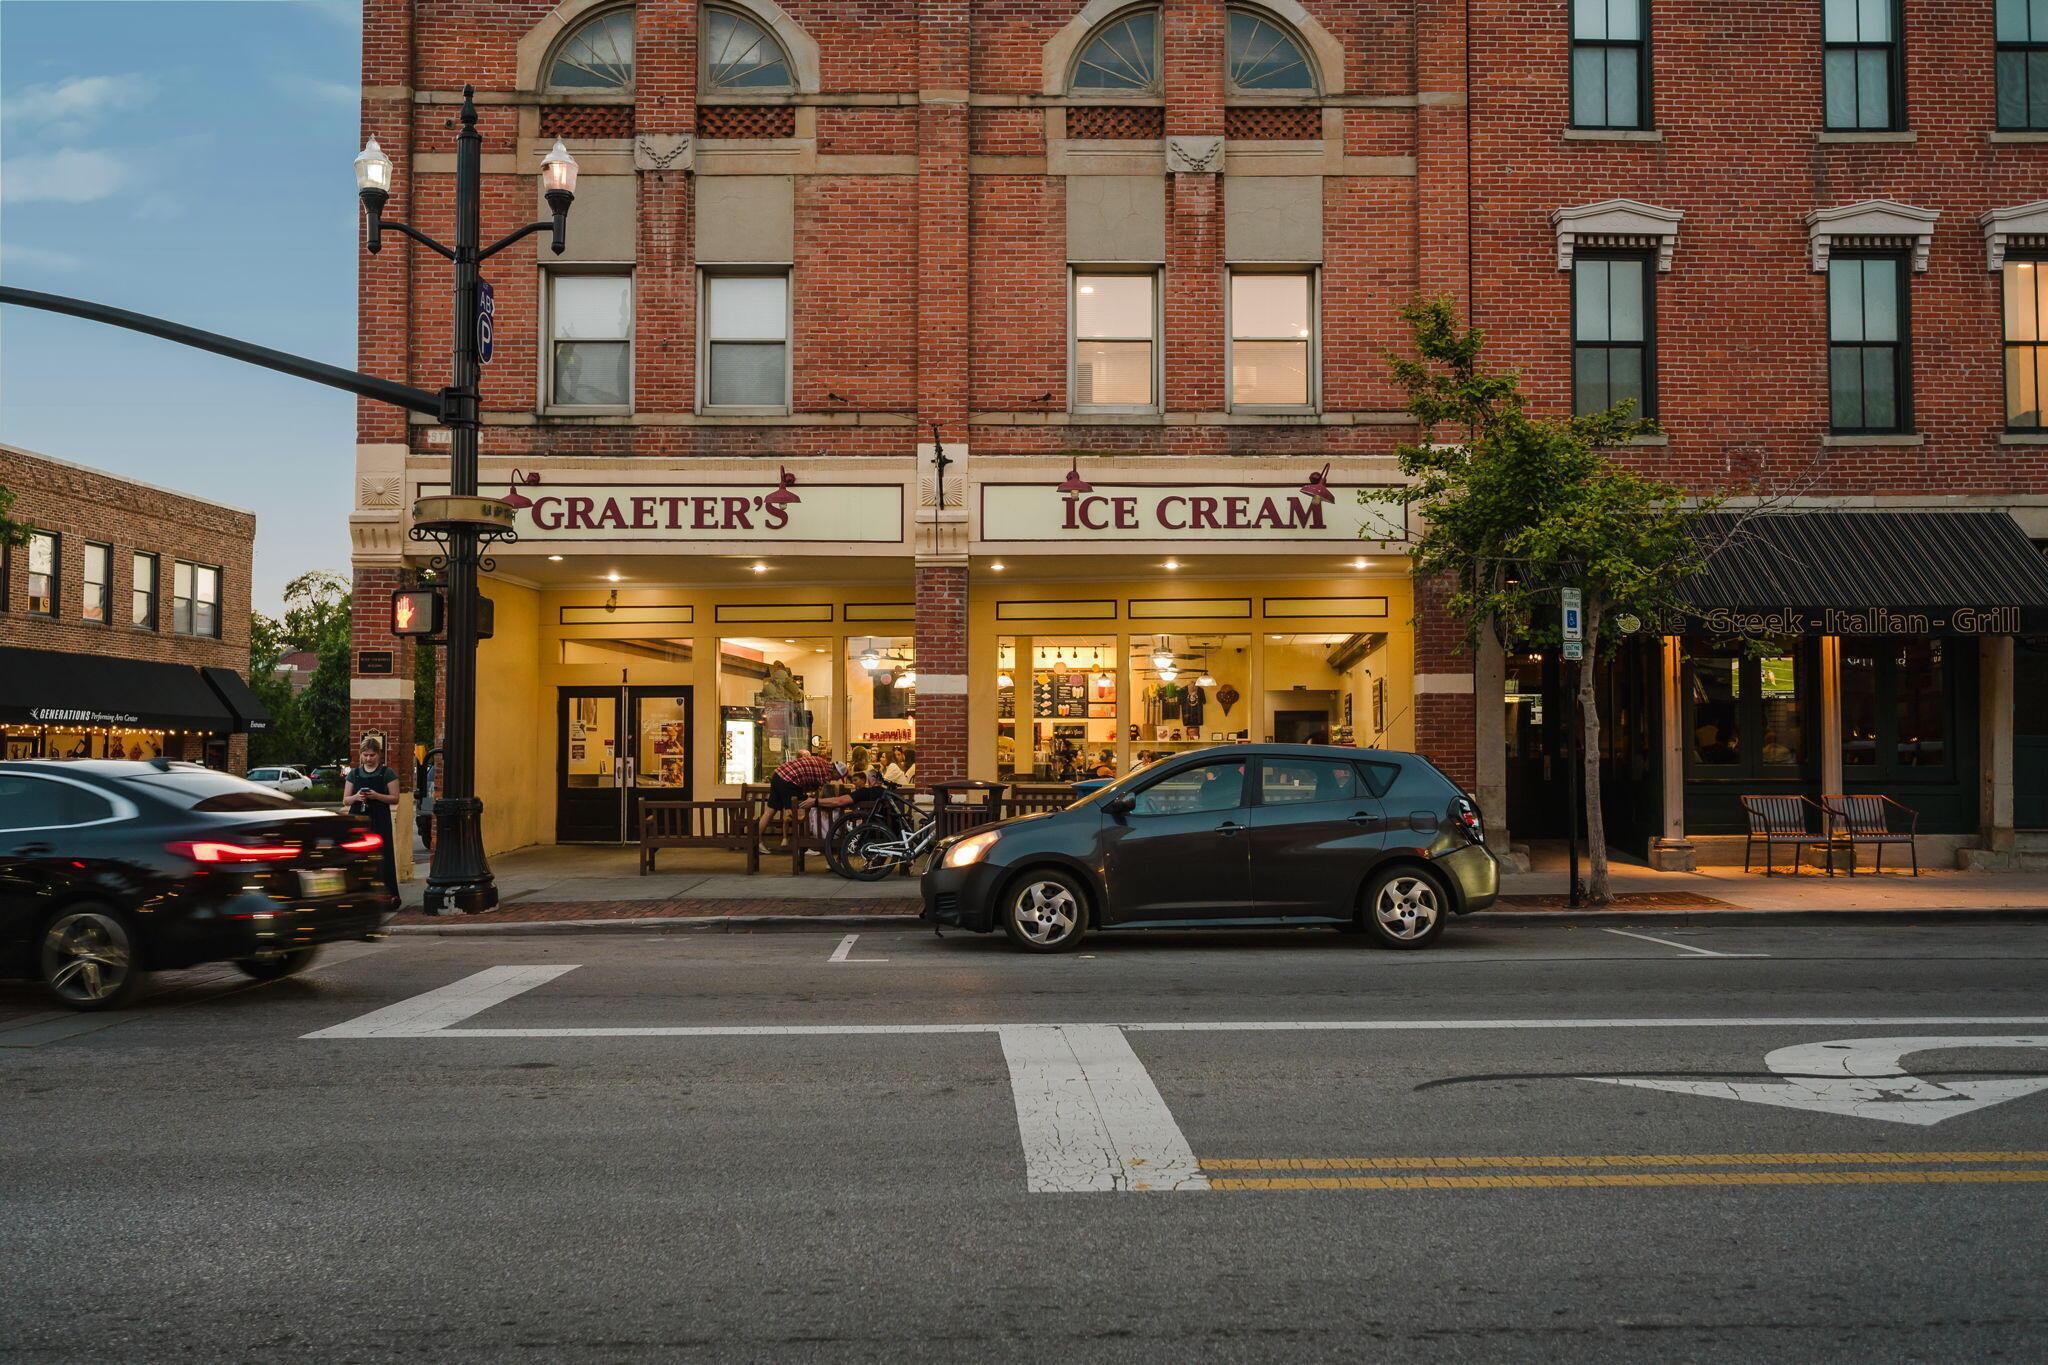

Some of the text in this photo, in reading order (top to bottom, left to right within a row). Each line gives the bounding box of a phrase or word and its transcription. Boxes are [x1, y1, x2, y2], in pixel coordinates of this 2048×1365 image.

[481, 320, 491, 354] P
[531, 496, 789, 531] GRAETER'S
[1061, 495, 1327, 530] ICE CREAM
[1706, 607, 1804, 634] Greek
[1825, 607, 1929, 634] Italian
[1952, 607, 2020, 634] Grill
[622, 668, 628, 683] 1
[40, 708, 91, 721] GENERATIONS
[91, 712, 114, 723] Performing
[124, 714, 138, 722] Center
